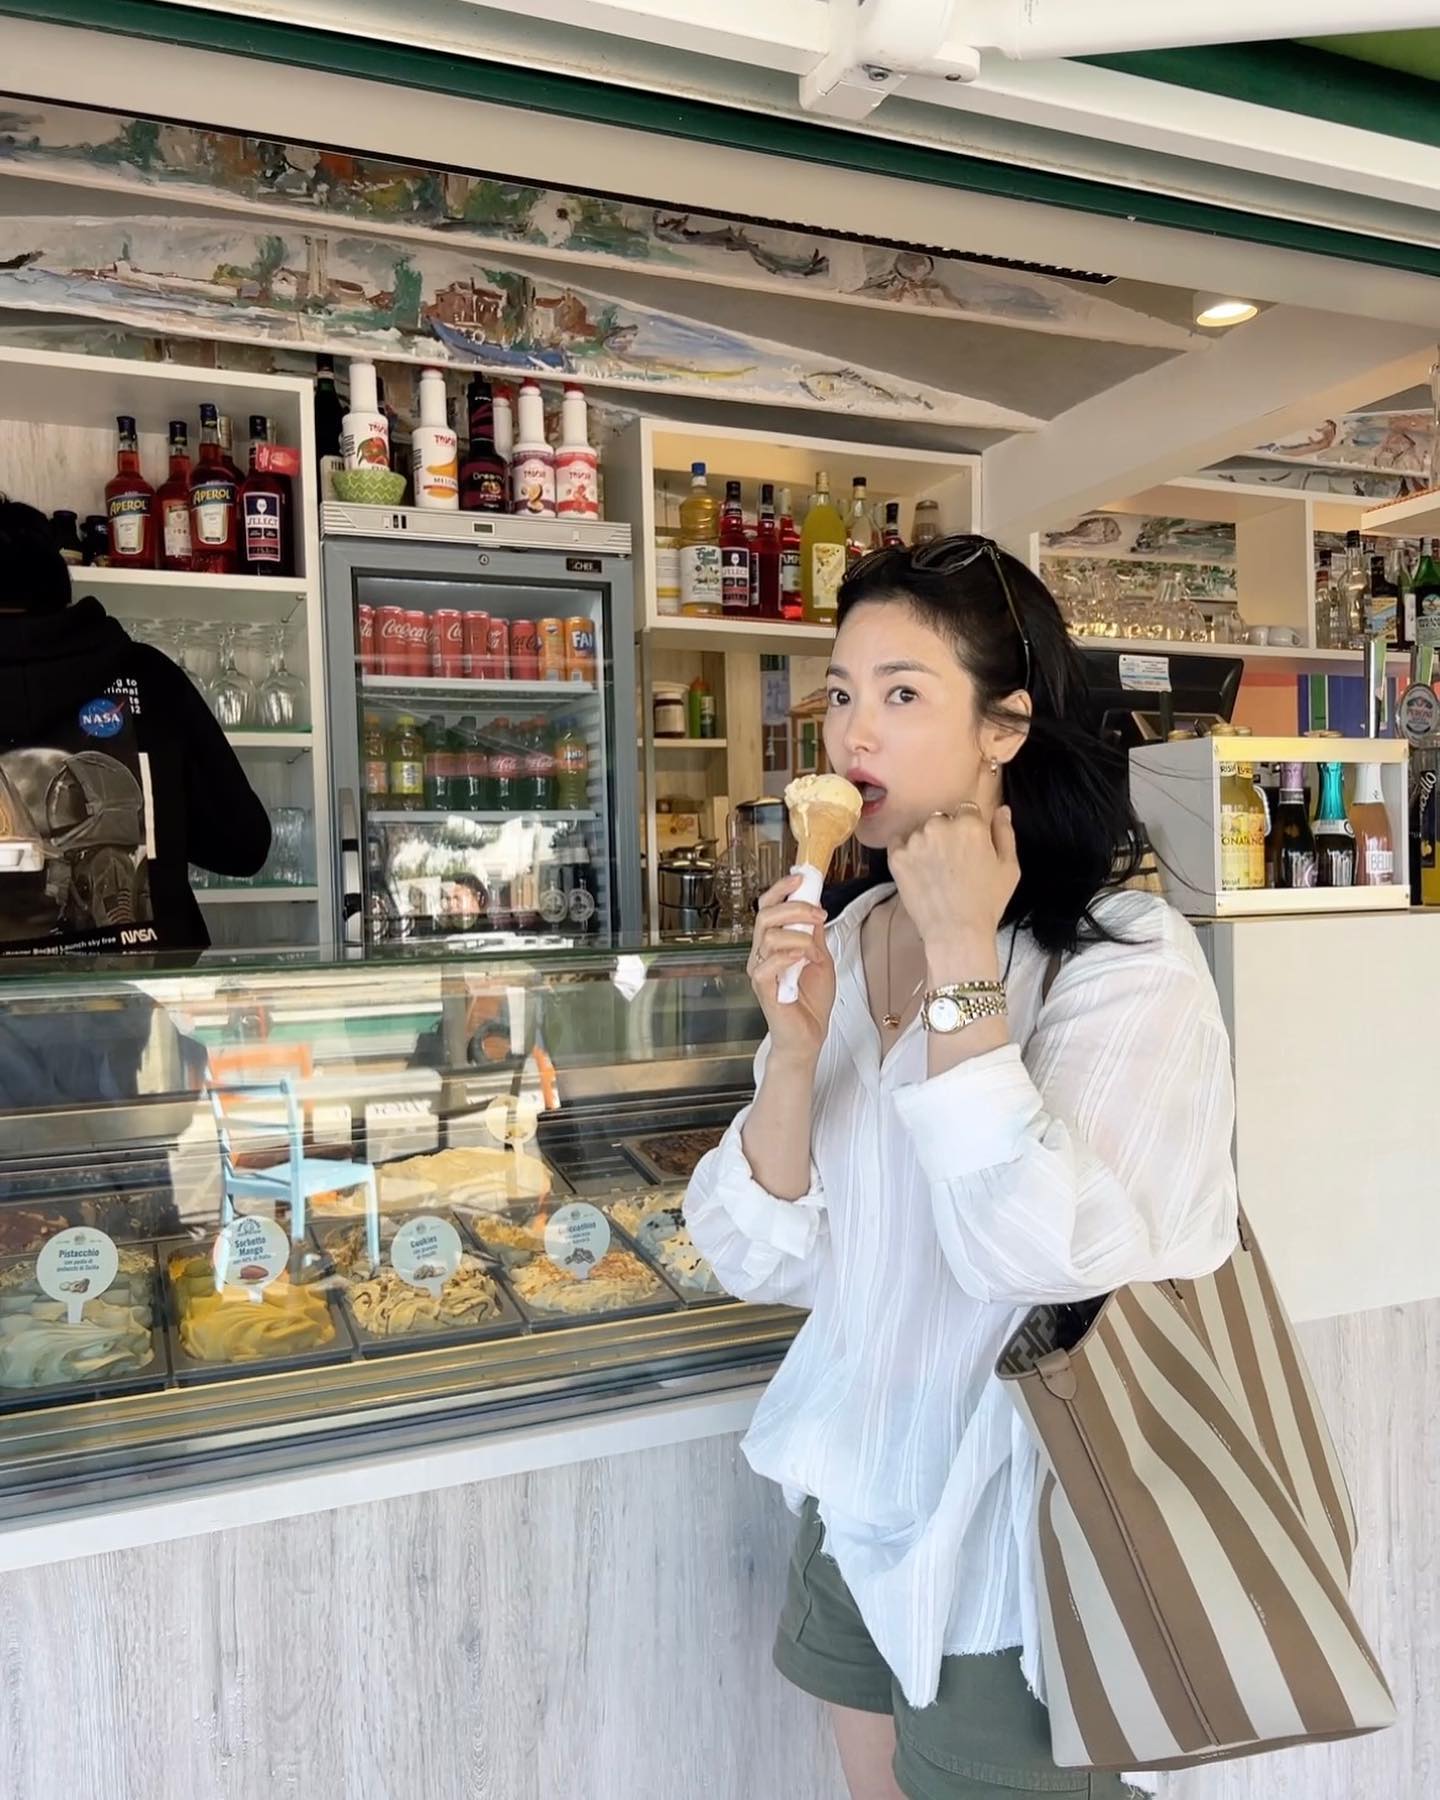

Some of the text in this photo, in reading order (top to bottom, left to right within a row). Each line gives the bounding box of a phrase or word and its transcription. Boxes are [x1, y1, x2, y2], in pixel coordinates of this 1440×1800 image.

[192, 487, 231, 506] APEROL
[110, 499, 147, 518] APEROL
[82, 712, 121, 726] NASA
[120, 927, 158, 945] NASA
[234, 1236, 267, 1249] Sorbetto
[59, 1247, 100, 1258] Pistacchio
[239, 1246, 264, 1256] Mango
